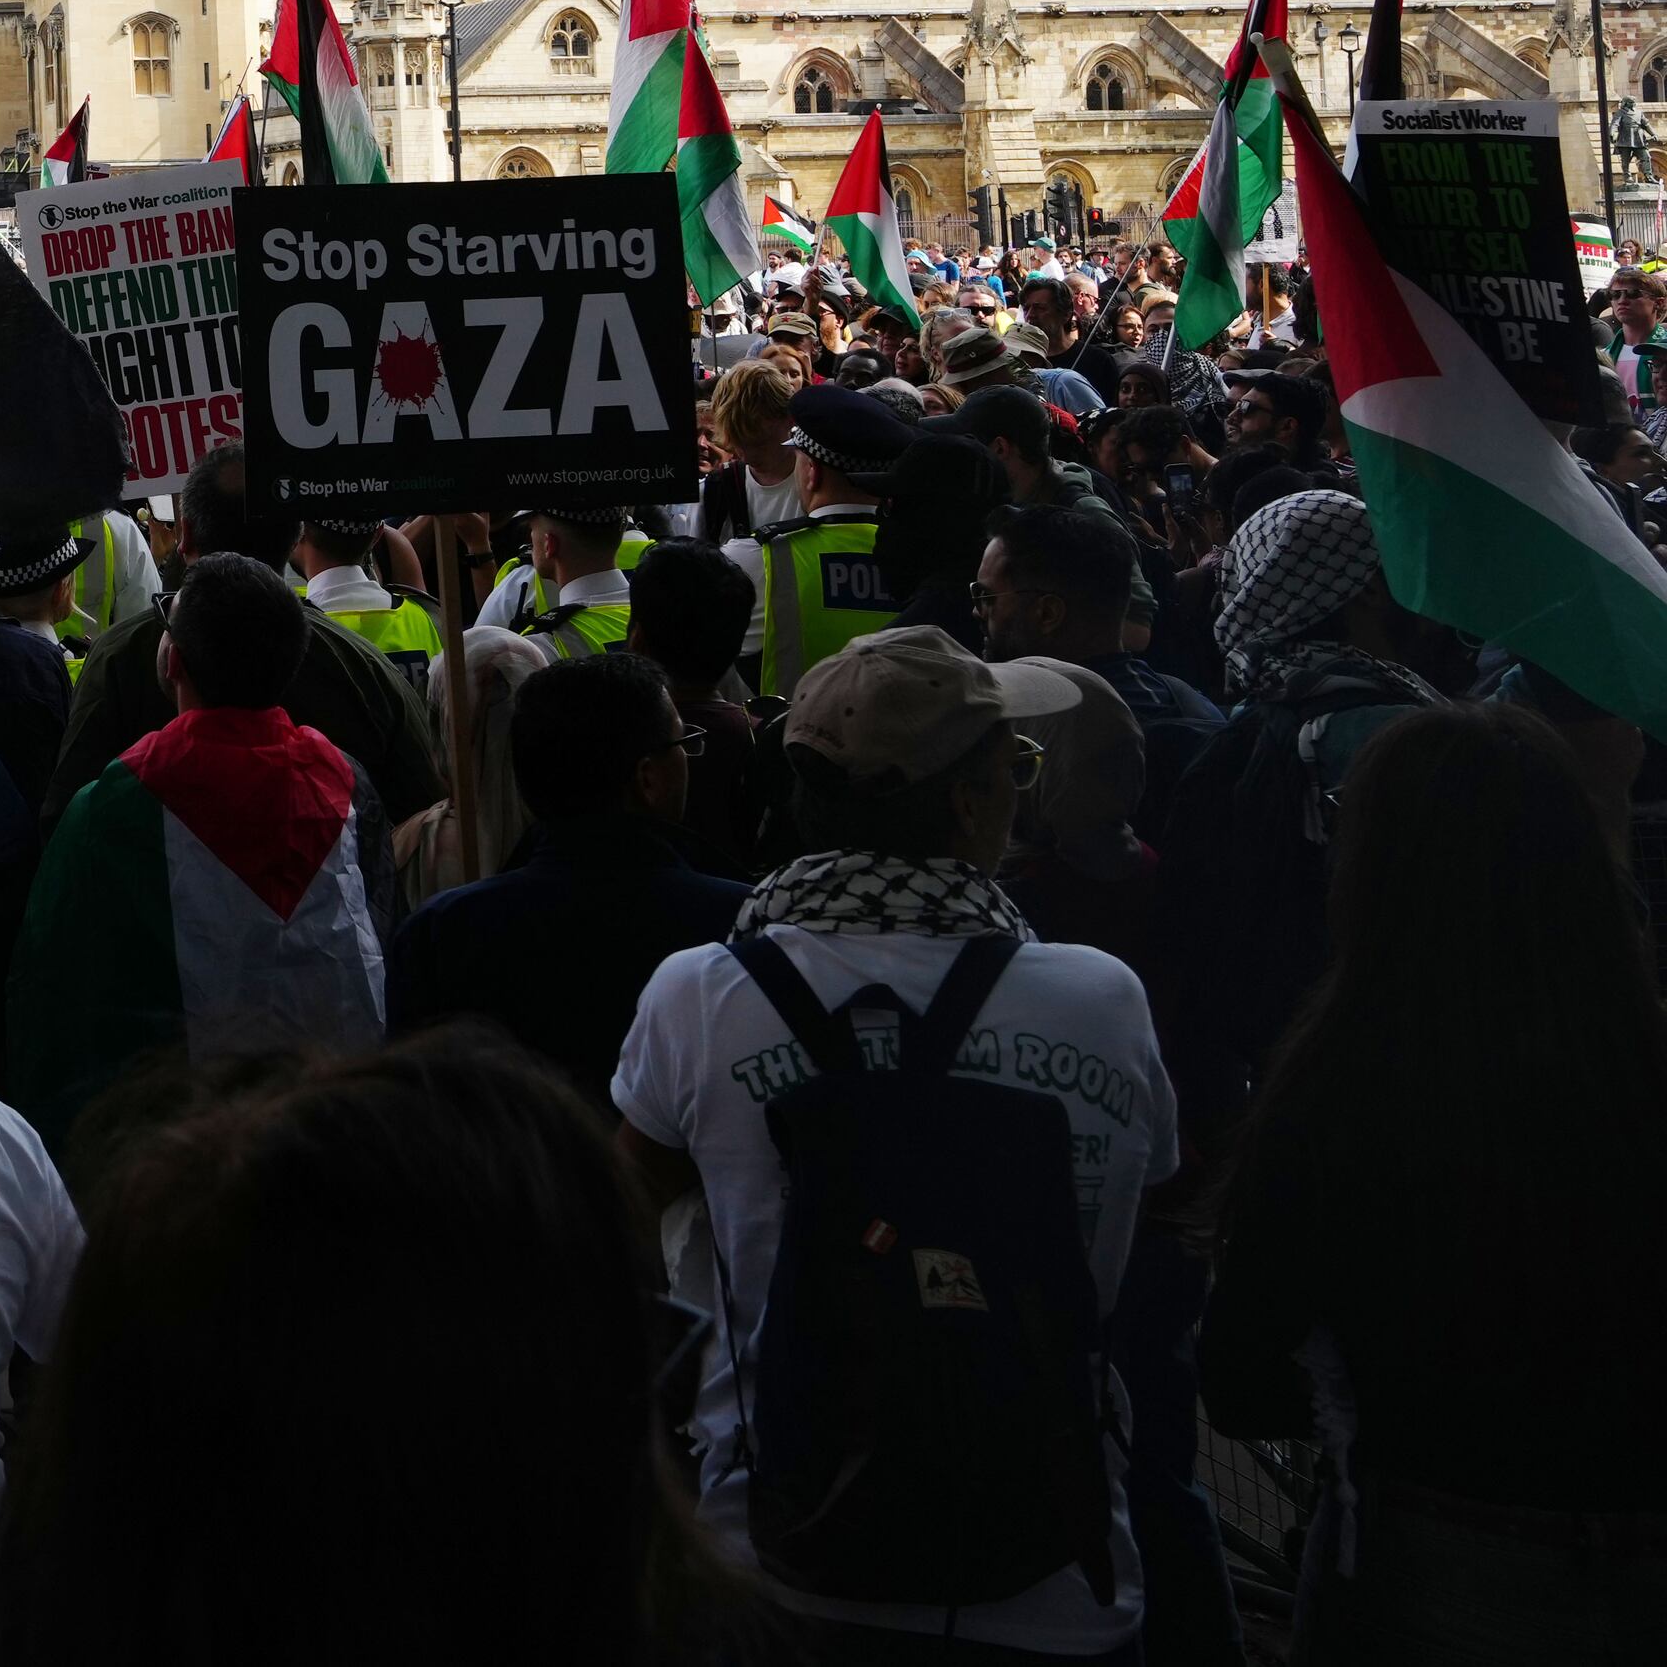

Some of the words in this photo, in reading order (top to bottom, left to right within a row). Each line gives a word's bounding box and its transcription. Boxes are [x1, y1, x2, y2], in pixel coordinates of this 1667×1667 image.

[1378, 141, 1468, 184] FROM
[1478, 141, 1540, 186] THE
[65, 205, 101, 221] Stop
[102, 200, 127, 215] the
[128, 195, 160, 210] War
[162, 186, 229, 206] coalition
[1490, 188, 1533, 231] TO
[41, 224, 117, 278] DROP
[119, 215, 174, 265] THE
[175, 205, 236, 257] BAN
[262, 228, 389, 291] Stop
[406, 219, 657, 279] Starving
[1465, 232, 1530, 274] SEA
[1579, 257, 1613, 269] LESTINE
[48, 264, 180, 335] DEFEND
[1430, 274, 1571, 324] ALESTINE
[1497, 321, 1543, 364] BE
[82, 325, 194, 406] IGHT
[267, 292, 670, 450] GAZA
[122, 394, 244, 482] OTES
[298, 481, 334, 497] Stop
[336, 480, 359, 494] the
[361, 478, 390, 493] War
[392, 476, 456, 492] coalition
[507, 465, 675, 486] www.stopwar.org.uk
[827, 562, 890, 602] POL
[1014, 1032, 1135, 1128] ROOM
